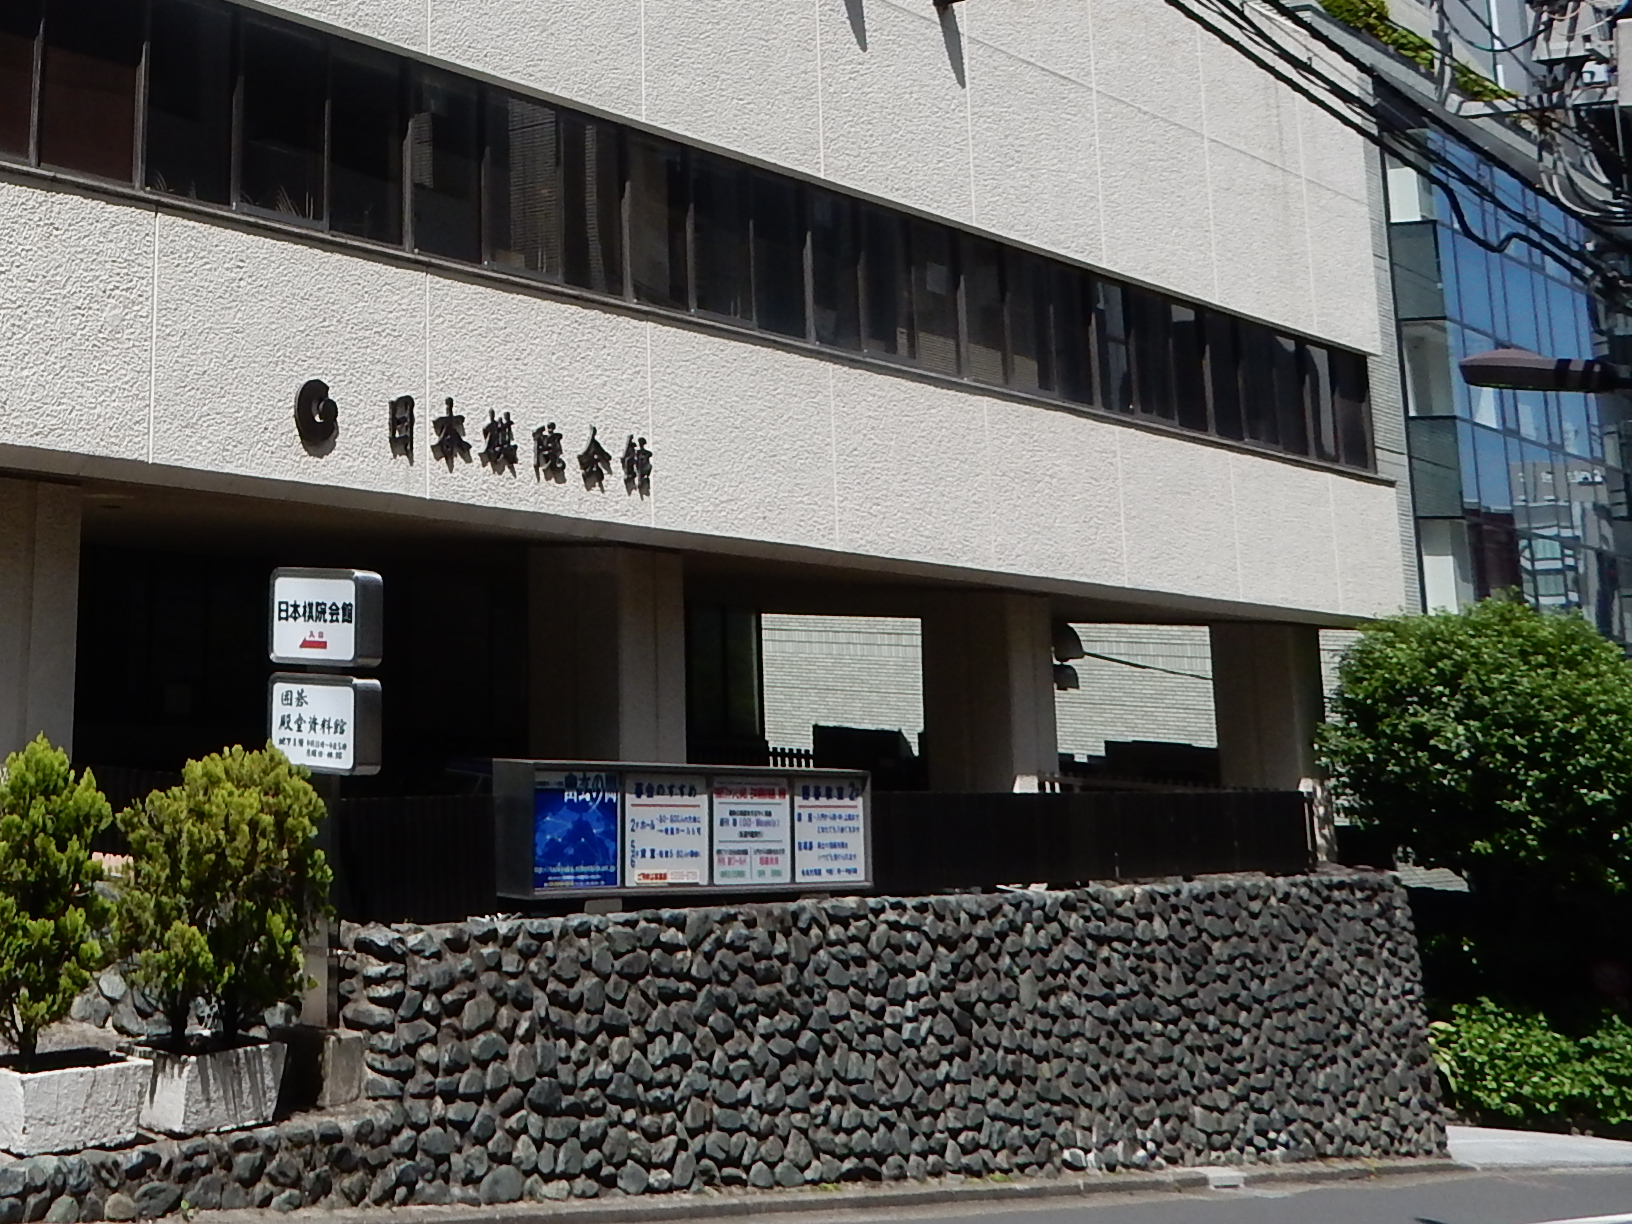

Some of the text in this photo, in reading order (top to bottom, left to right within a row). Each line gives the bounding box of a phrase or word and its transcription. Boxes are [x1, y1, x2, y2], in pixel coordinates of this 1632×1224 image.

[388, 394, 653, 488] 日本棋院会館
[277, 600, 353, 624] 日本棋院会館
[281, 688, 308, 708] 囲碁
[278, 712, 347, 736] 殿堂資料館
